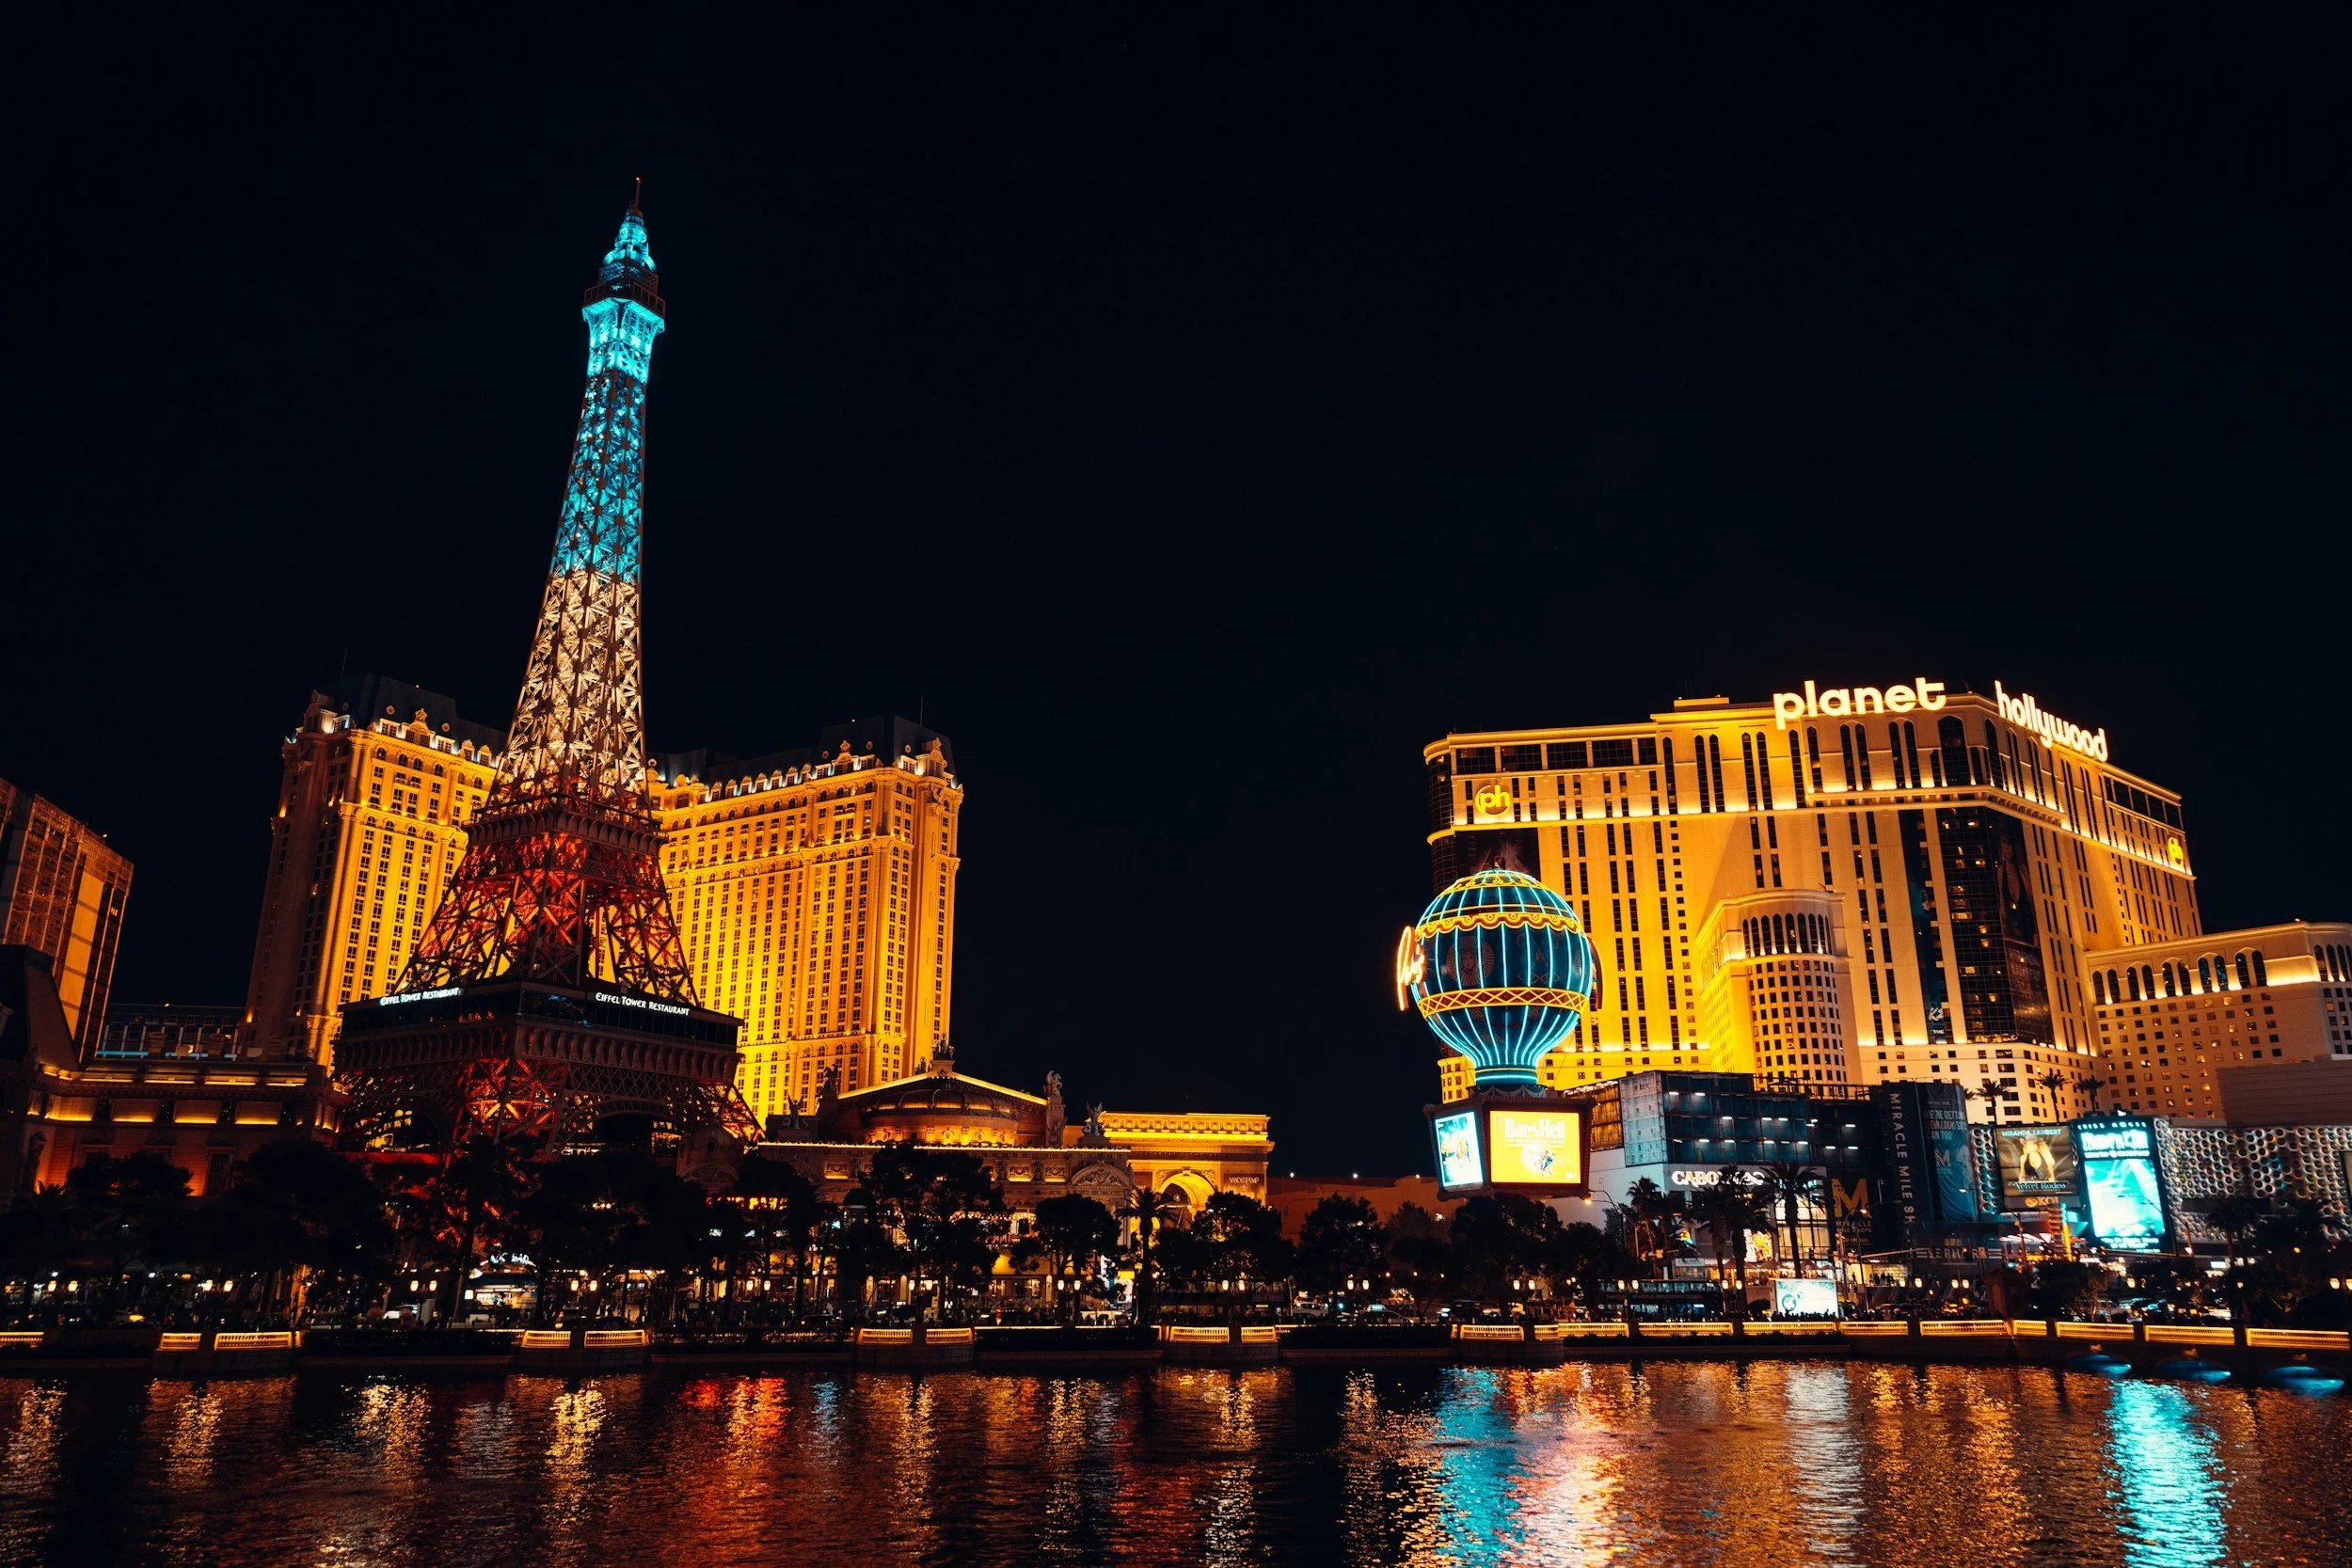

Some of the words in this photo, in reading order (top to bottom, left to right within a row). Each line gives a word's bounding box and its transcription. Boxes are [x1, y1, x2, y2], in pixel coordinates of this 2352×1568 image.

[1773, 676, 1947, 731] planet
[1994, 679, 2108, 762] hollywood
[379, 996, 400, 1006] EIFFEL
[400, 992, 421, 1003] TOWER
[421, 988, 459, 1000] RESTAURANT
[596, 992, 620, 1005] EIFFEL
[621, 996, 646, 1008] TOWER
[648, 1001, 690, 1016] RESTAURANT
[1890, 1093, 1908, 1159] MIRACLE
[1899, 1165, 1914, 1199] MILE
[1671, 1170, 1720, 1187] CABO
[1830, 1178, 1868, 1218] M
